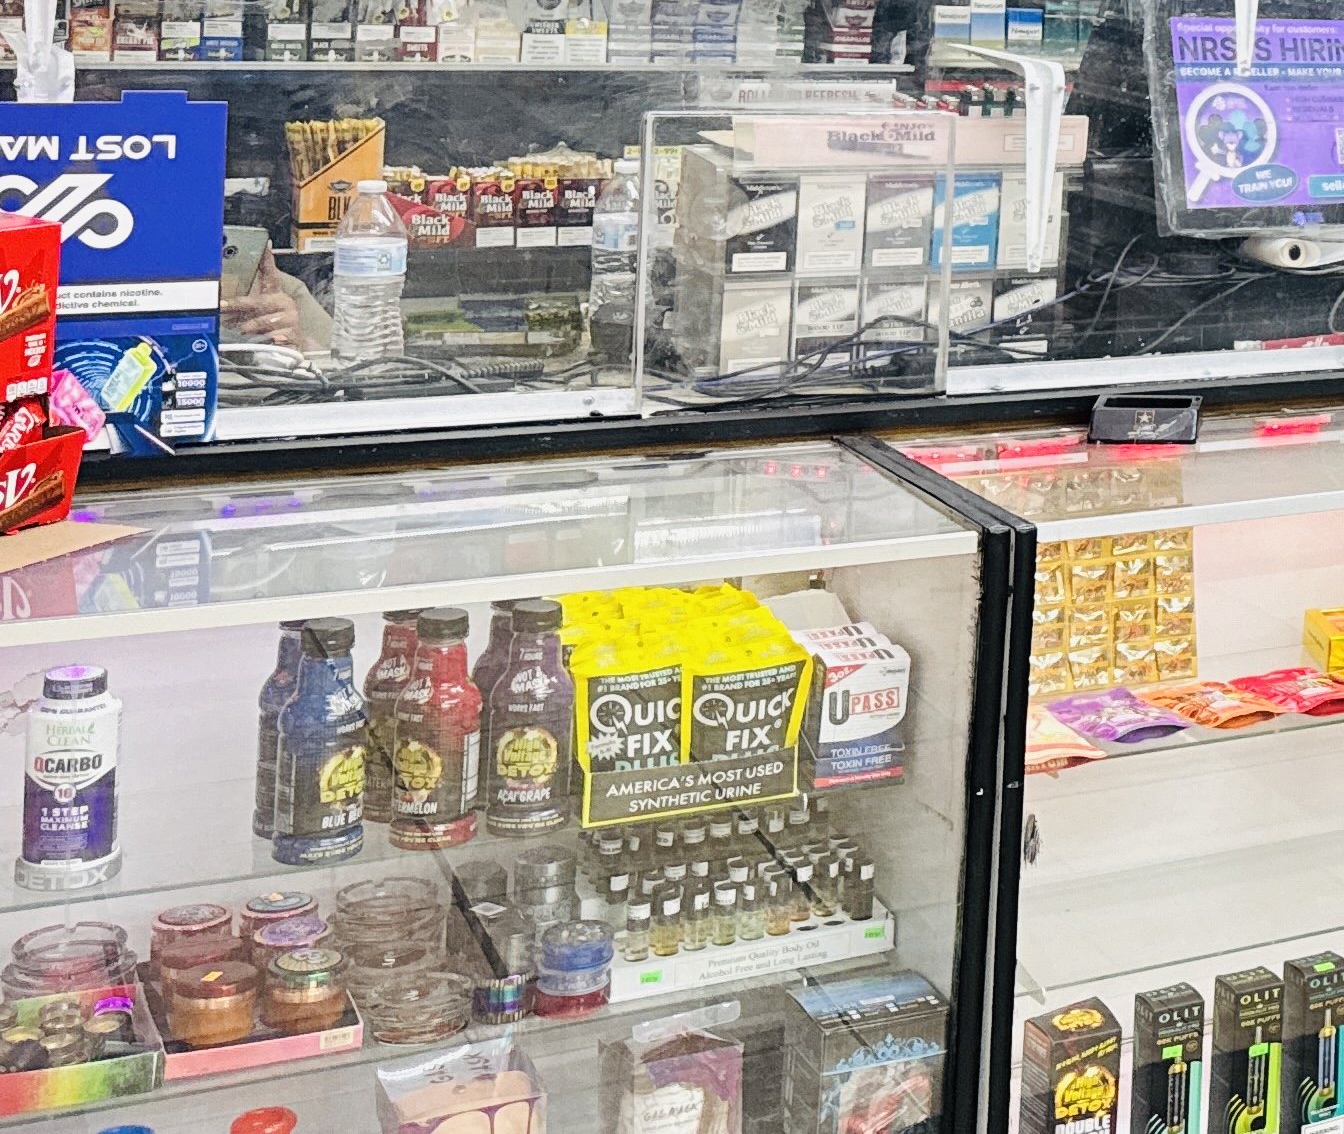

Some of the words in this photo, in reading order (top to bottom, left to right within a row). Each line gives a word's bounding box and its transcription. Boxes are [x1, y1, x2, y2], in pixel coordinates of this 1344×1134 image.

[1179, 36, 1236, 60] NRS
[1181, 68, 1221, 76] BECOME
[1288, 68, 1315, 76] MAKE
[69, 135, 176, 160] LOST
[411, 214, 451, 226] Black
[418, 224, 451, 237] Mild
[120, 289, 163, 297] nicotine.
[92, 300, 139, 308] chemical.
[177, 380, 206, 388] 10000
[177, 398, 205, 407] 15000
[852, 690, 898, 714] PASS
[47, 737, 91, 746] CLEAN
[628, 733, 672, 757] FIX
[726, 726, 770, 751] FIX
[35, 754, 103, 773] QCARBO
[831, 758, 861, 770] TOXIN
[864, 754, 892, 767] FREE
[698, 770, 745, 787] MOST
[749, 762, 783, 778] USED
[628, 792, 716, 813] SYNTHETIC
[717, 783, 762, 800] URINE
[53, 806, 88, 815] STEP
[18, 867, 108, 889] DETOX
[1241, 989, 1280, 1006] OLIT
